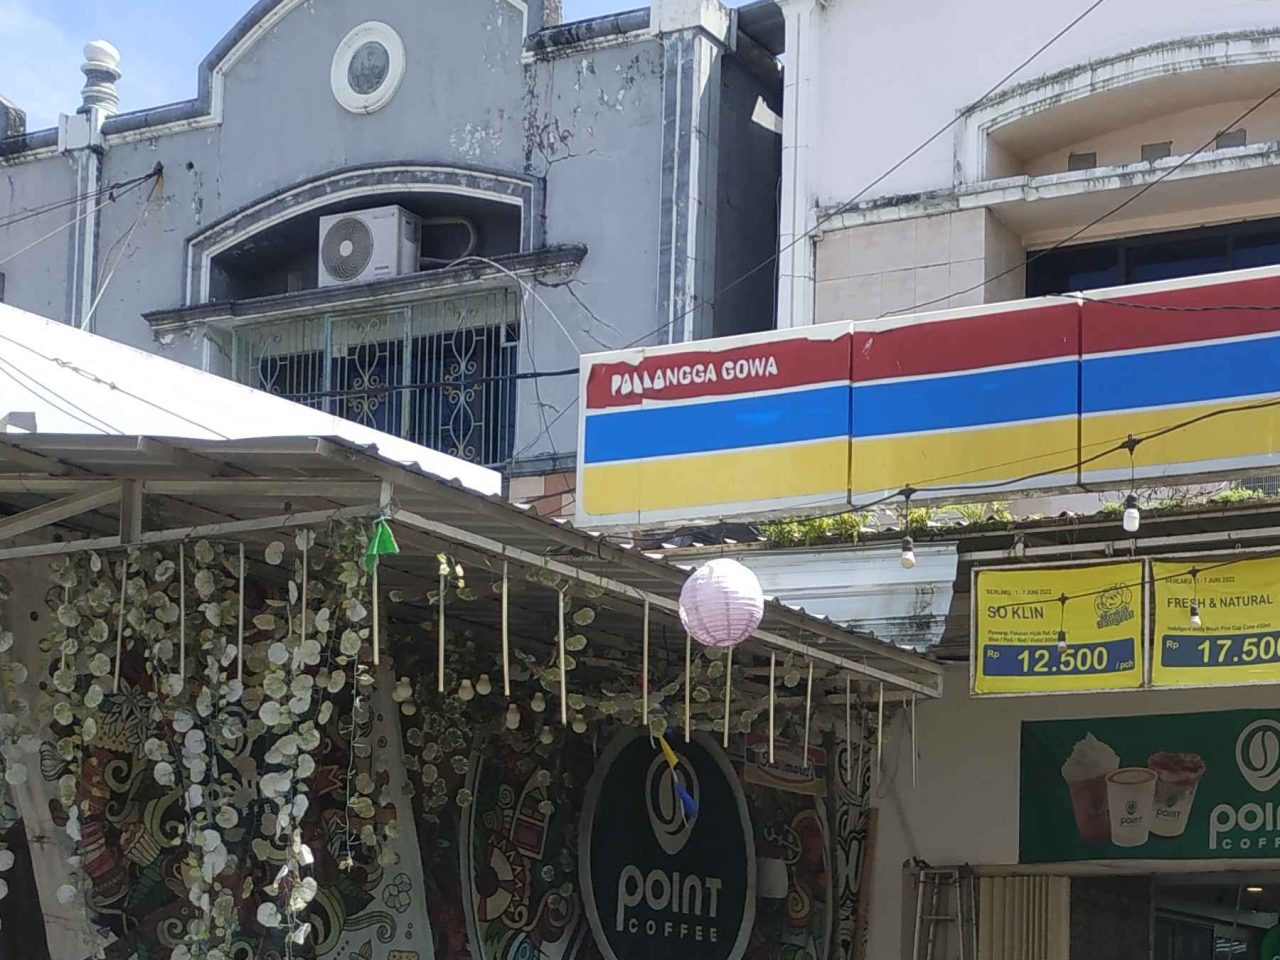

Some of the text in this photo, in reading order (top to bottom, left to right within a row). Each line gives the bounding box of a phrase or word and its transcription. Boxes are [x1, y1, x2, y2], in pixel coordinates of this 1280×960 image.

[721, 355, 778, 381] GOWA
[1167, 596, 1206, 609] FRESH
[1209, 597, 1217, 609] &
[1223, 594, 1273, 608] NATURAL
[987, 605, 1044, 620] SO KLIN
[1166, 640, 1180, 650] Rp
[987, 646, 1109, 673] Rp 12.500
[1120, 660, 1134, 671] pch
[628, 917, 718, 943] COFFEE
